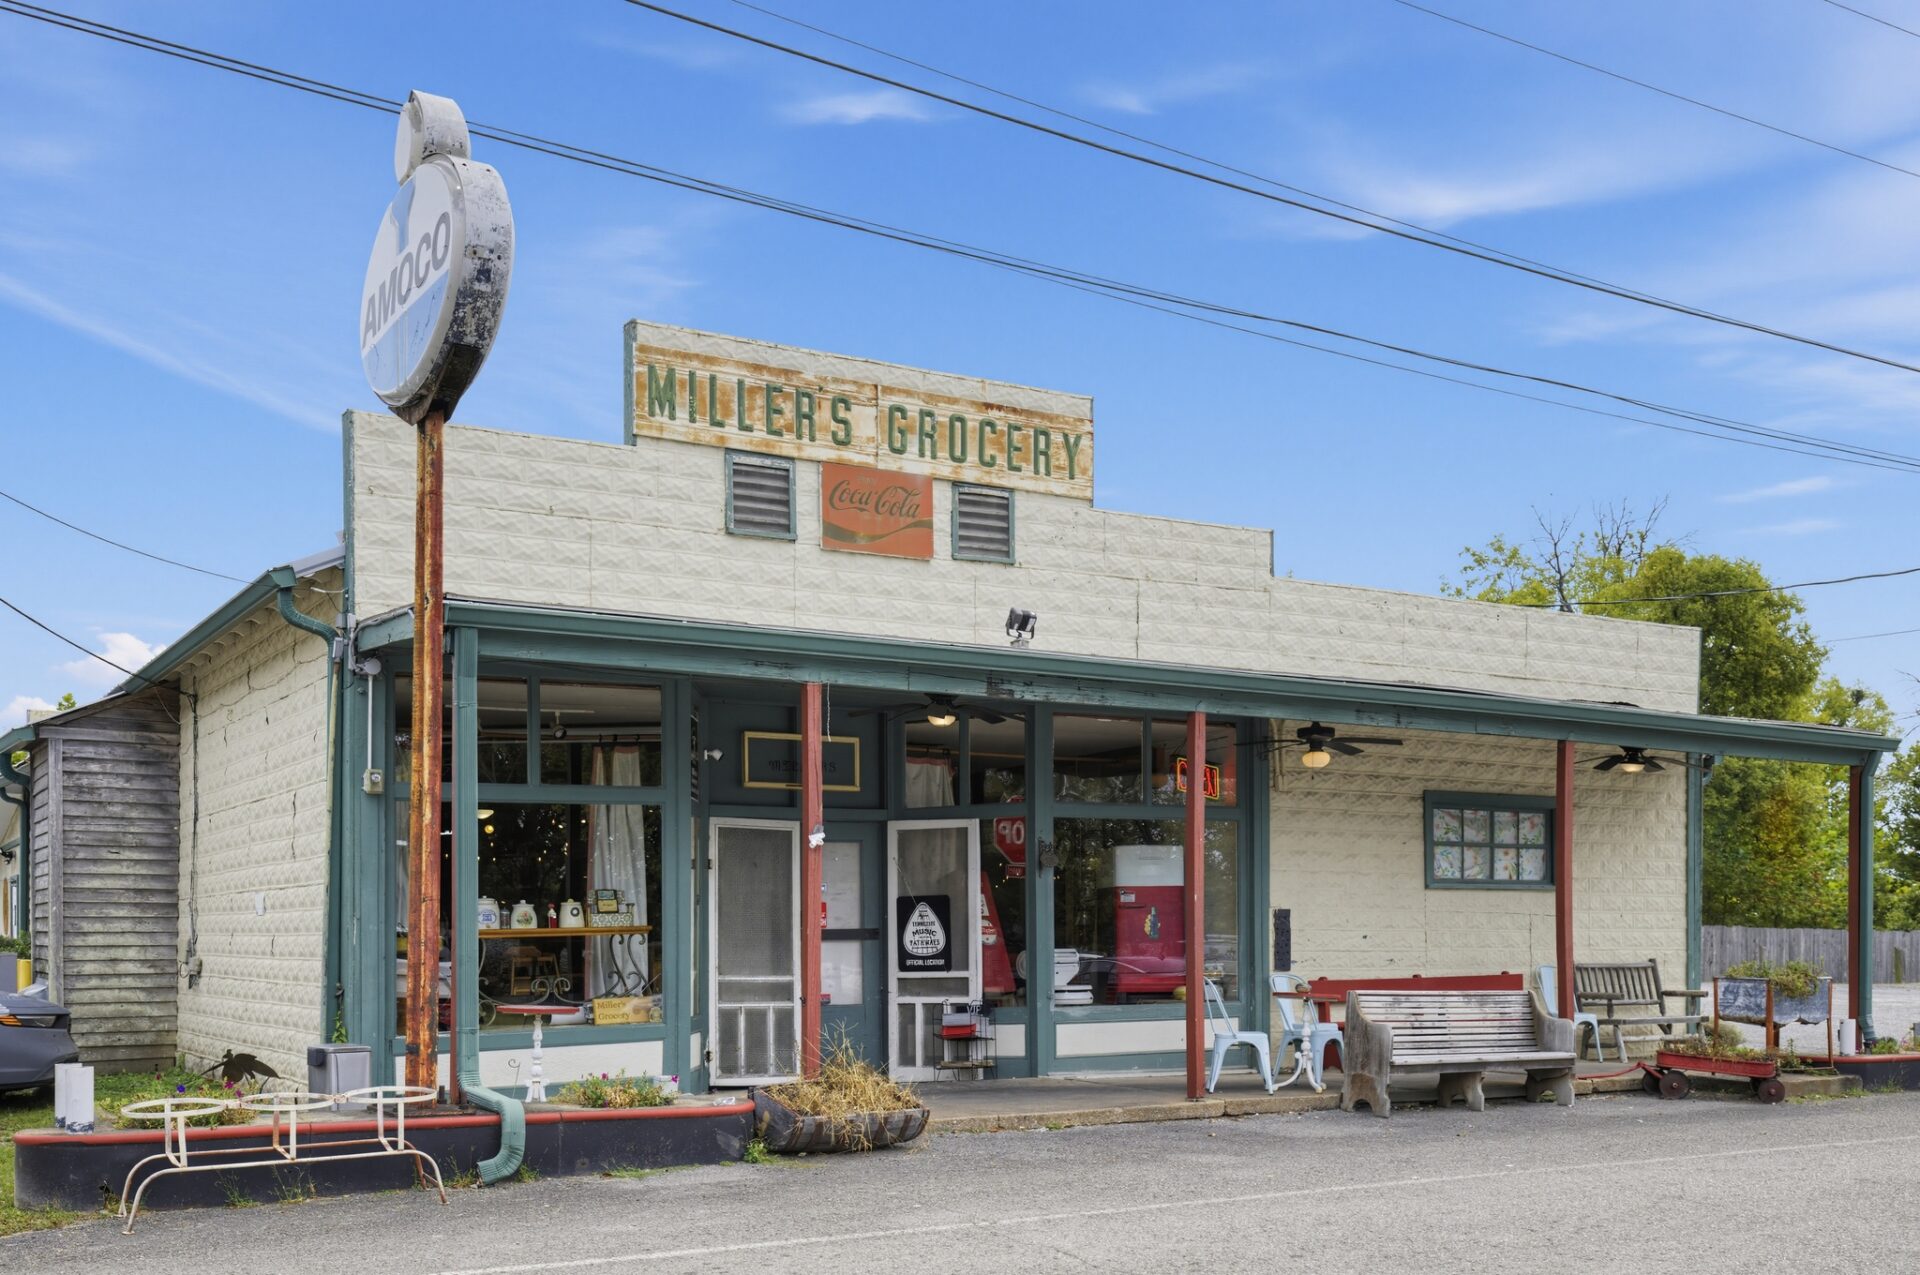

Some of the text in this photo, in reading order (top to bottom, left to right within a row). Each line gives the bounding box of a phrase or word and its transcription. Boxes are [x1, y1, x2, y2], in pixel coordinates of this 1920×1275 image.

[363, 212, 450, 348] AMOCO
[888, 404, 1083, 480] GROCERY
[1178, 760, 1217, 797] ON
